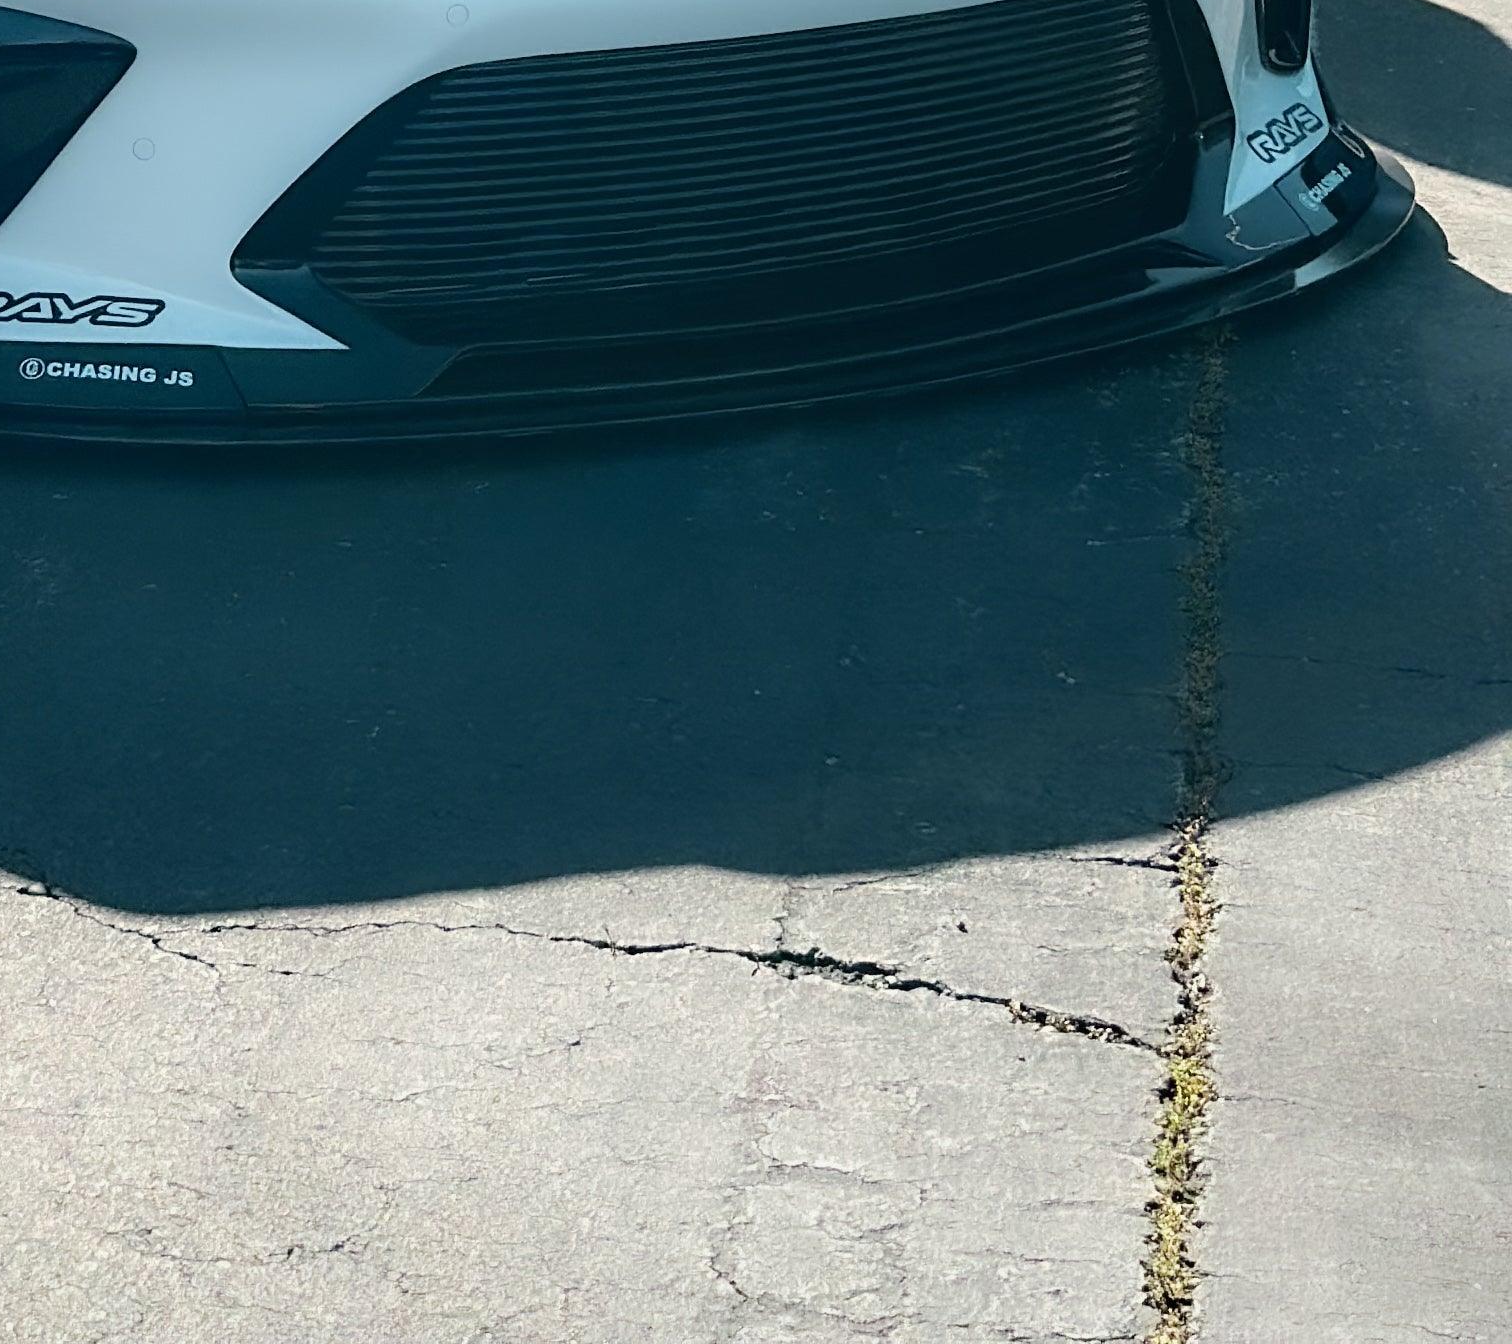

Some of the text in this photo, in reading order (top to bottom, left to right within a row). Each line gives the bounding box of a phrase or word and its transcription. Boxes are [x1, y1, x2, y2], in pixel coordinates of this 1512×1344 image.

[1246, 102, 1324, 164] RAYS
[45, 360, 194, 387] CHASING JS
